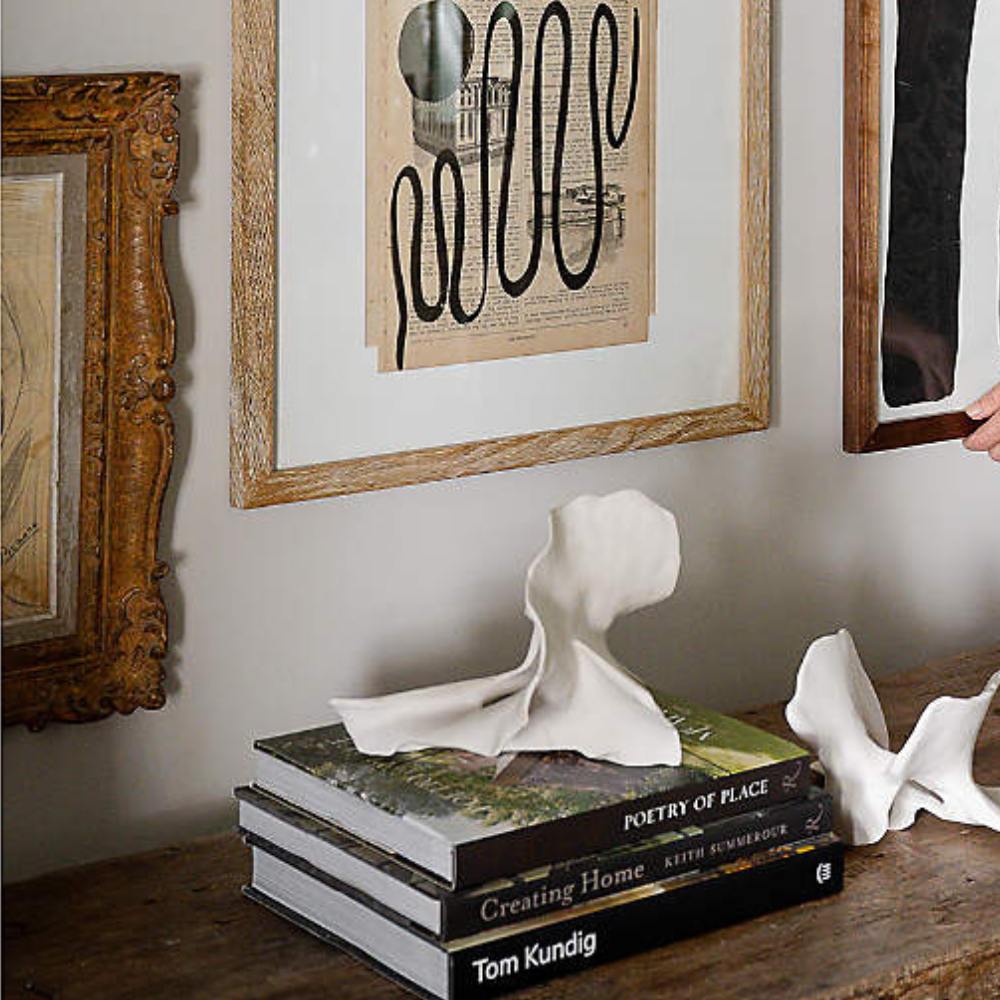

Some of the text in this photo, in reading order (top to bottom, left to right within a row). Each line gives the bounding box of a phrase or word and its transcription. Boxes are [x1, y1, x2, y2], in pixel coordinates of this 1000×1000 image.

[624, 779, 770, 831] POETRY OF PLACE
[480, 864, 646, 923] Creating Home
[472, 931, 597, 984] Tom Kundig
